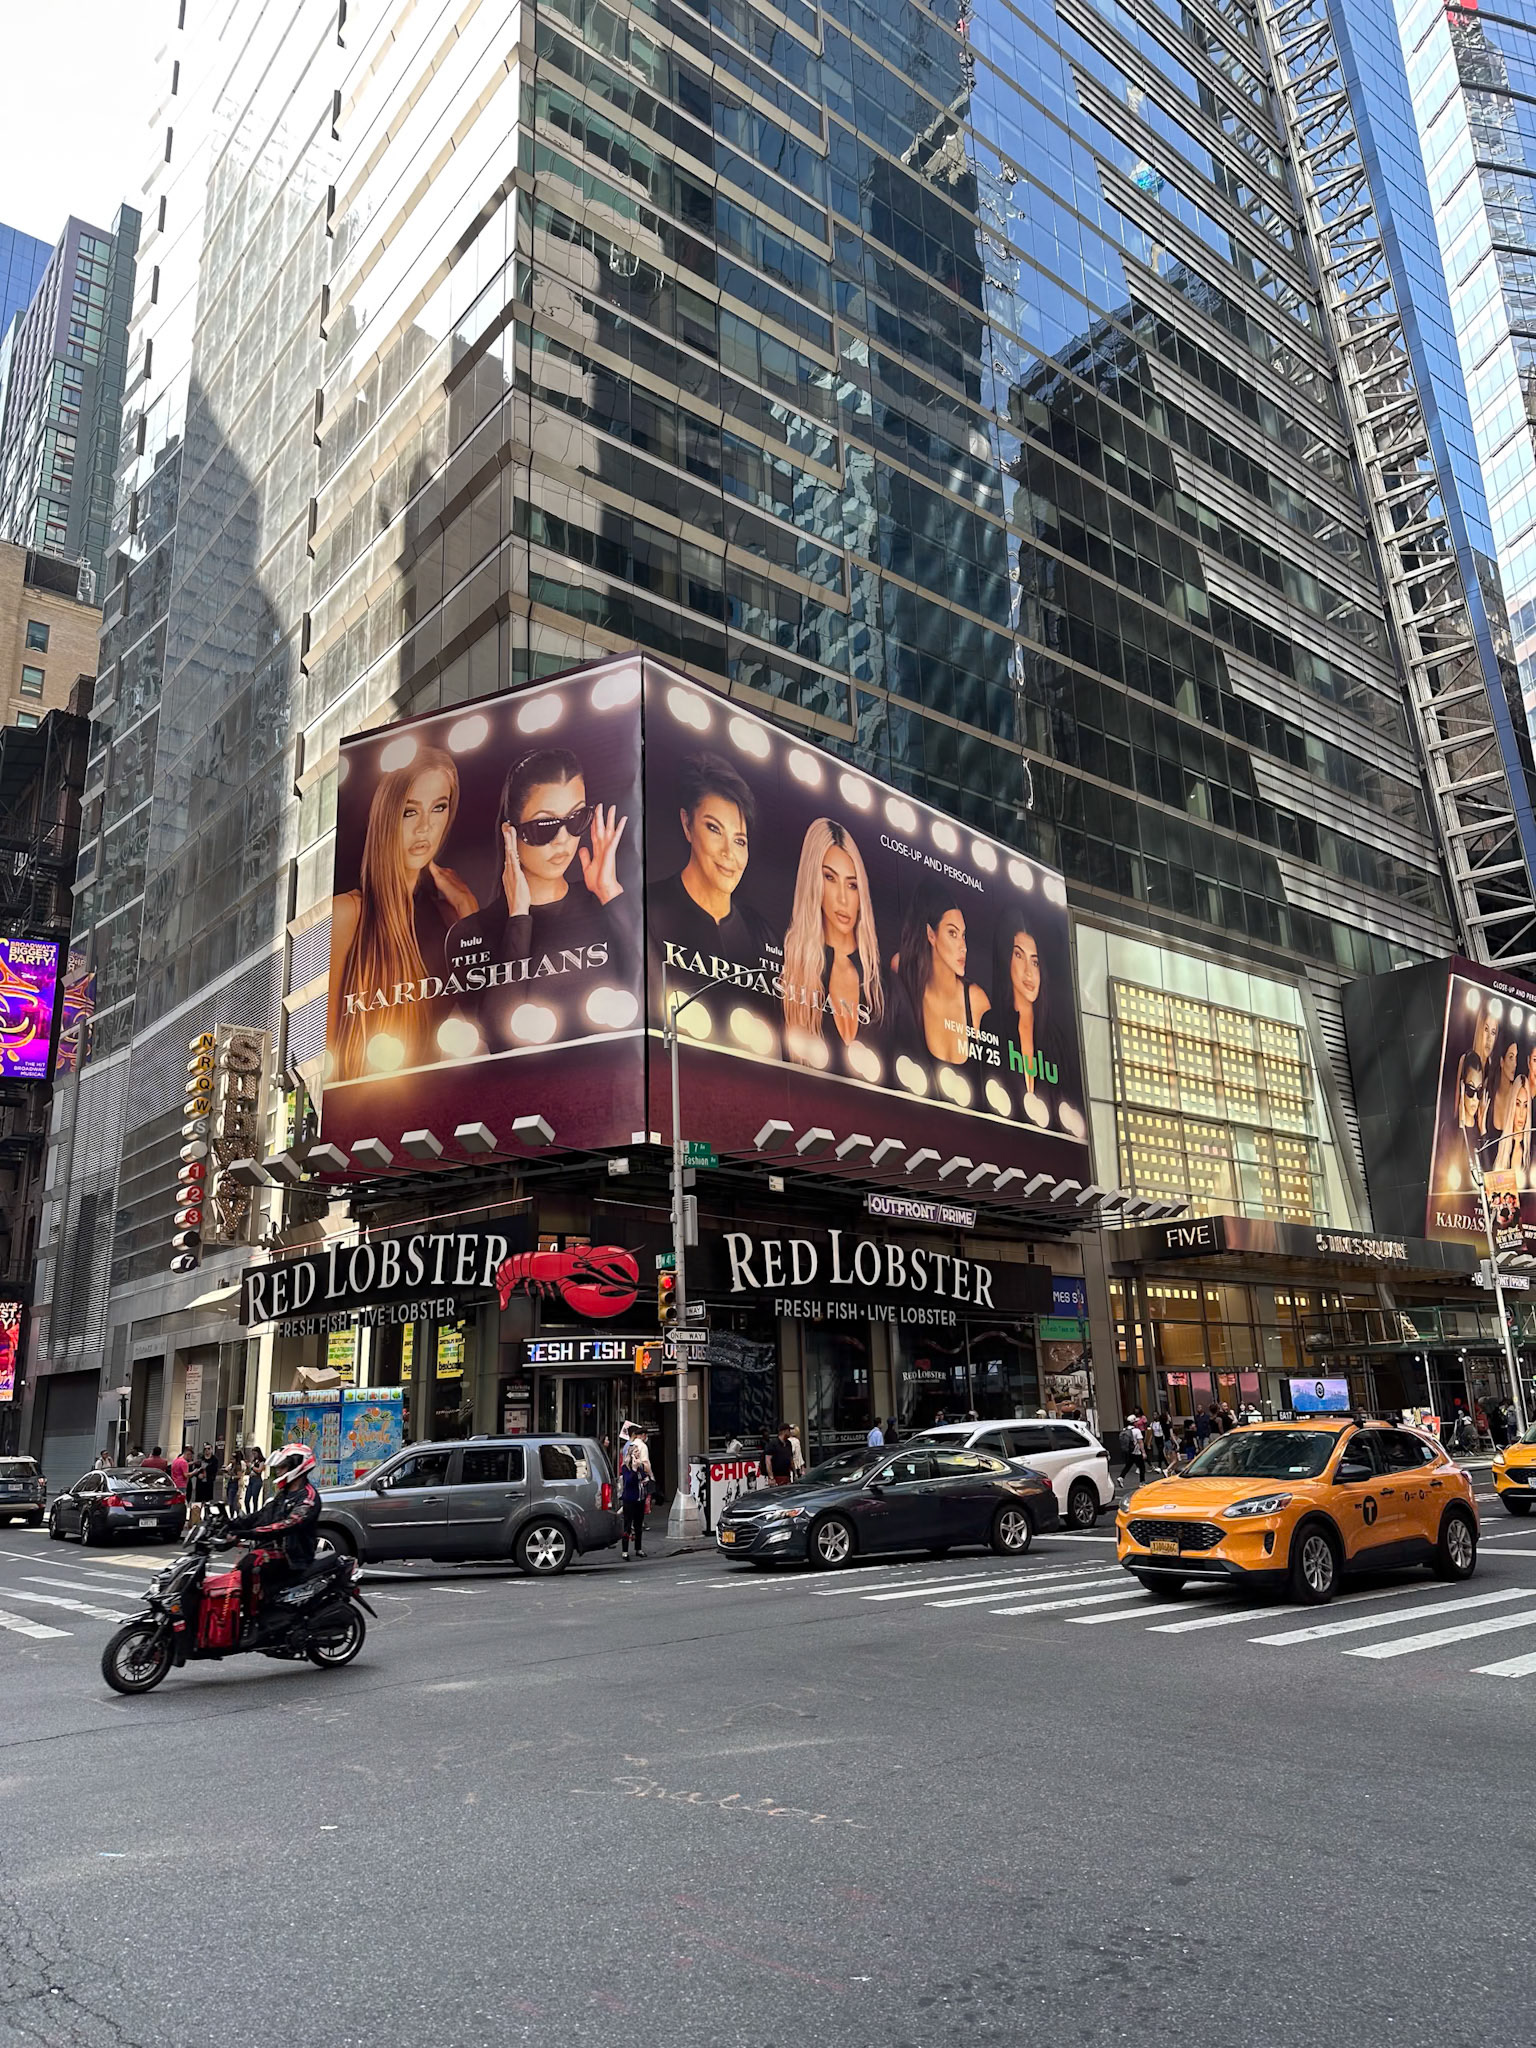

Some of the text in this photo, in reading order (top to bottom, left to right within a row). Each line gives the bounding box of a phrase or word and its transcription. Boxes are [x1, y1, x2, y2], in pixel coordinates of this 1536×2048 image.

[880, 834, 984, 892] CLOSE-UP AND PERSONAL
[9, 946, 56, 957] BIGGEST
[10, 941, 56, 951] BROADWAY'S
[460, 936, 483, 948] hulu
[9, 953, 55, 967] PARTY!
[452, 951, 490, 968] THE
[343, 942, 609, 1016] KARDASHIANS
[1493, 981, 1515, 994] CLOSE-UP
[944, 1018, 999, 1046] NEW SEASON
[957, 1038, 1001, 1066] MAY 25
[1008, 1040, 1058, 1084] hulu
[184, 1035, 212, 1269] N R Q W S 1 2 3 7
[694, 1143, 698, 1152] 7
[684, 1155, 708, 1165] Fashion
[872, 1197, 972, 1225] OUTFRONT PRIME
[1166, 1225, 1210, 1248] FIVE
[1316, 1234, 1328, 1251] 5
[723, 1229, 995, 1309] RED LOBSTER
[245, 1234, 508, 1328] RED LOBSTER
[1053, 1291, 1070, 1303] MES
[278, 1297, 455, 1338] FRESH FISH LIVE LOBSTER
[775, 1299, 956, 1326] FRESH FISH LIVE LOBSTER
[671, 1332, 703, 1340] ONE WAY
[580, 1341, 626, 1360] FISH
[902, 1369, 946, 1380] RED LOBSTER
[1365, 1501, 1374, 1522] T
